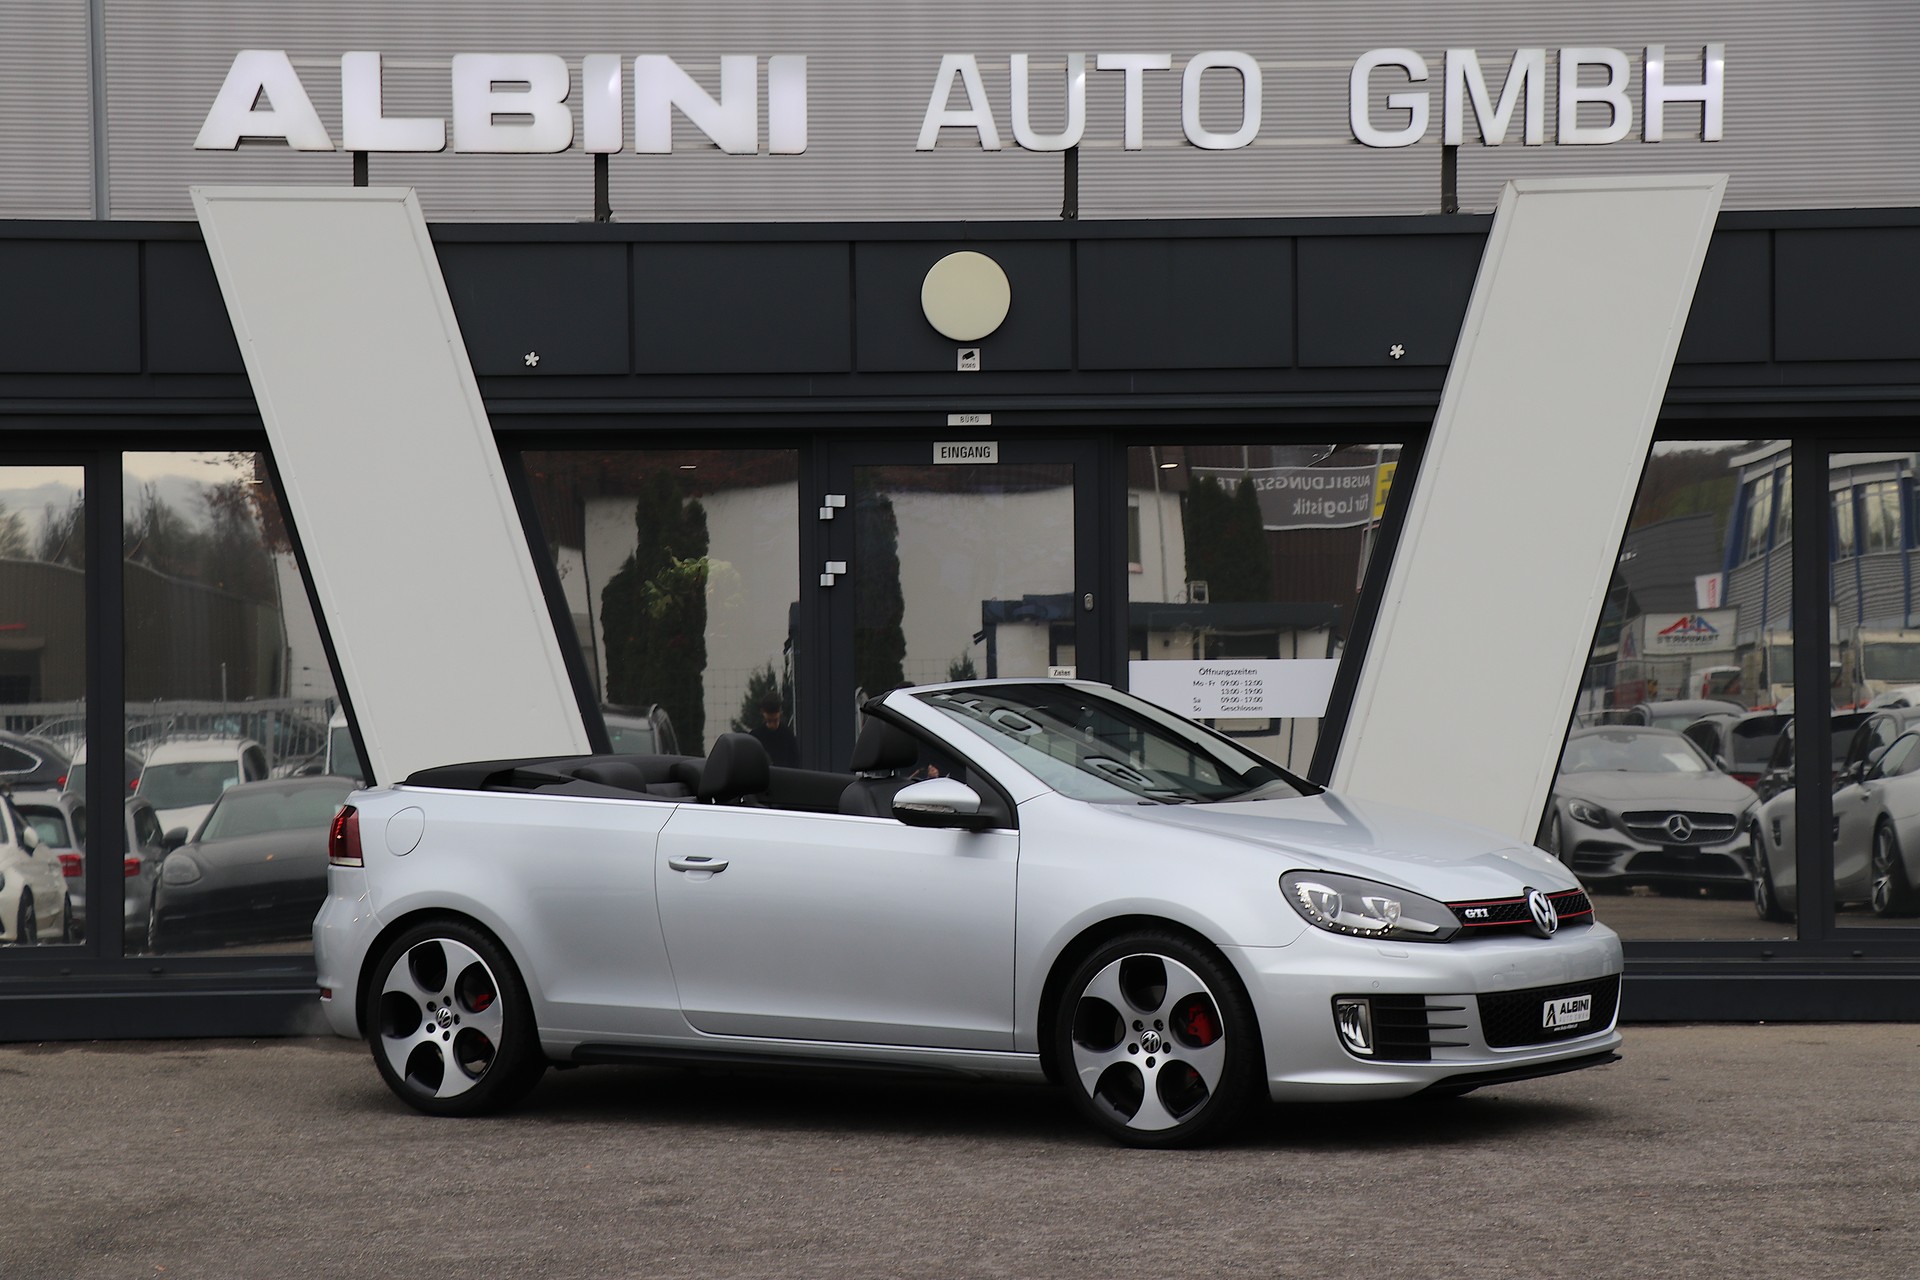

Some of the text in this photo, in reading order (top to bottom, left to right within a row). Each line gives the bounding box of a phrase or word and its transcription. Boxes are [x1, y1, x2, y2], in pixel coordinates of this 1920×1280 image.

[193, 43, 1726, 155] ALBINI AUTO GMBH
[941, 446, 991, 459] EINGANG
[1464, 908, 1490, 919] GTI
[1560, 999, 1590, 1014] ALBINI
